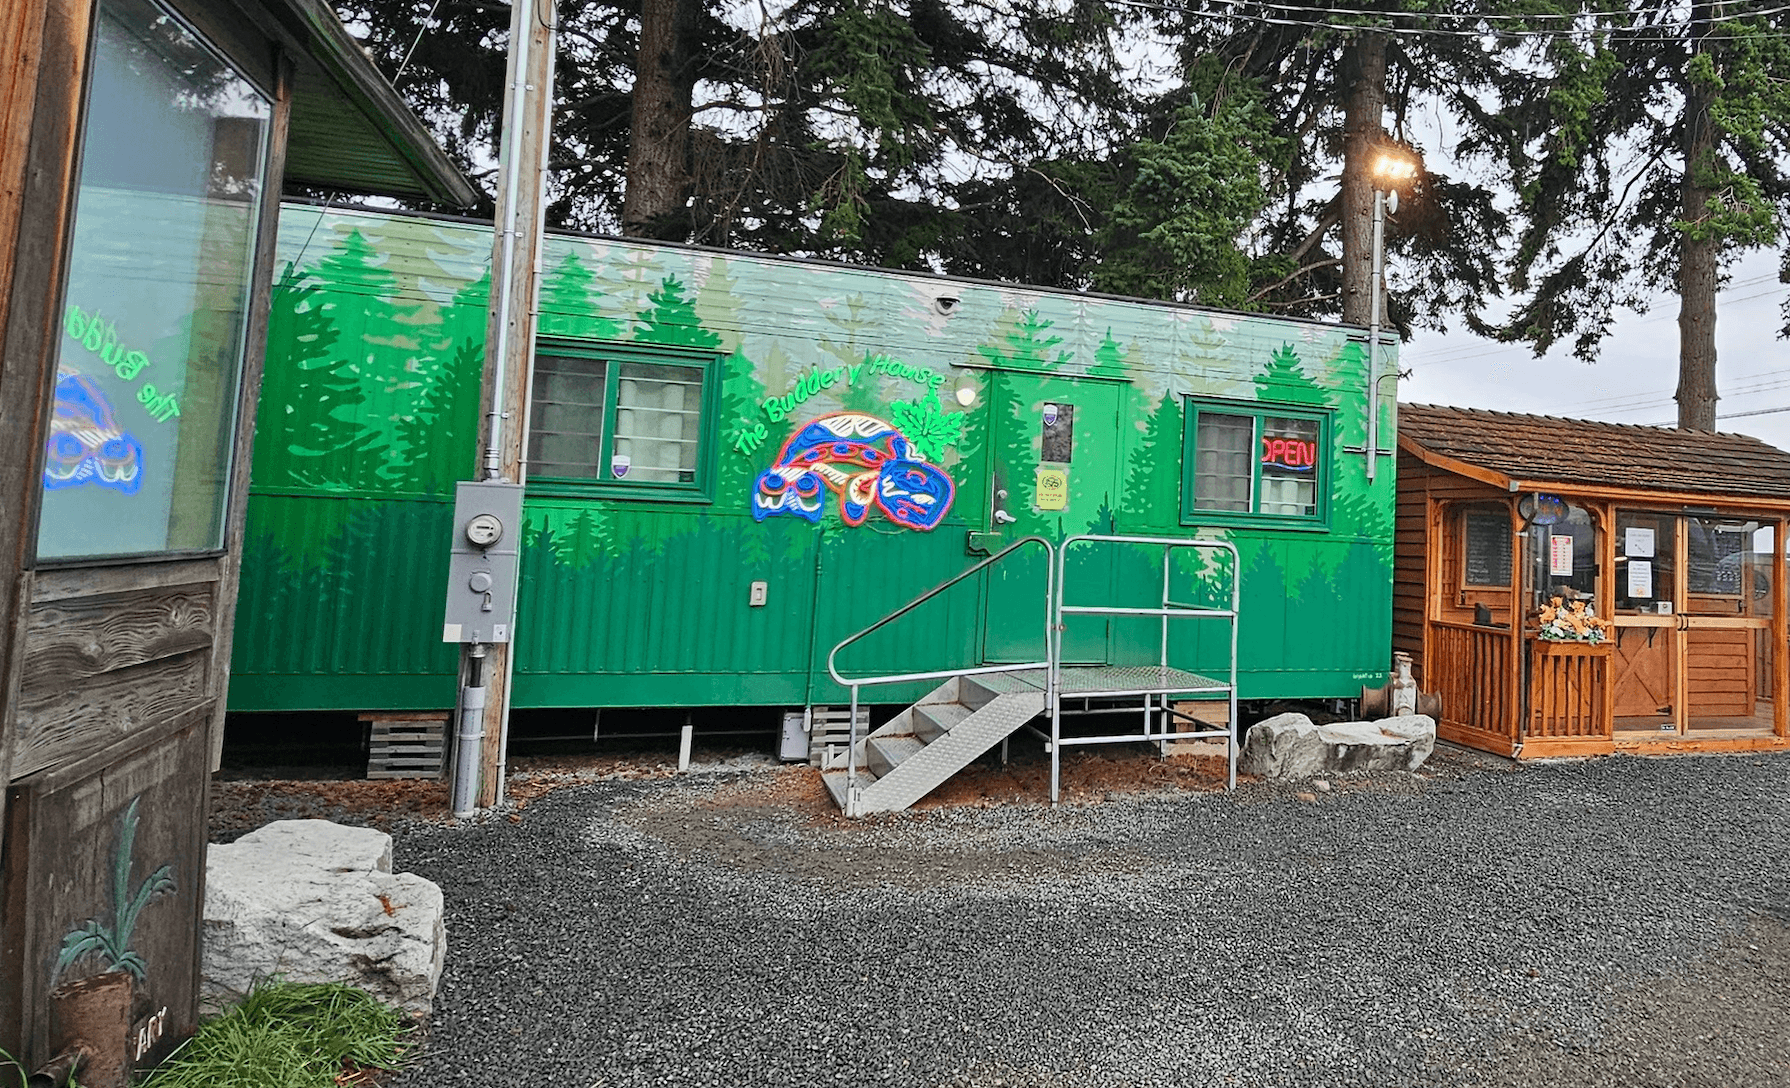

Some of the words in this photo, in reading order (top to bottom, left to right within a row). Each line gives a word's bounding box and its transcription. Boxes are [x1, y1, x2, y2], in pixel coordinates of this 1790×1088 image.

[735, 422, 769, 456] The
[762, 361, 862, 423] Buddery
[868, 352, 946, 389] House
